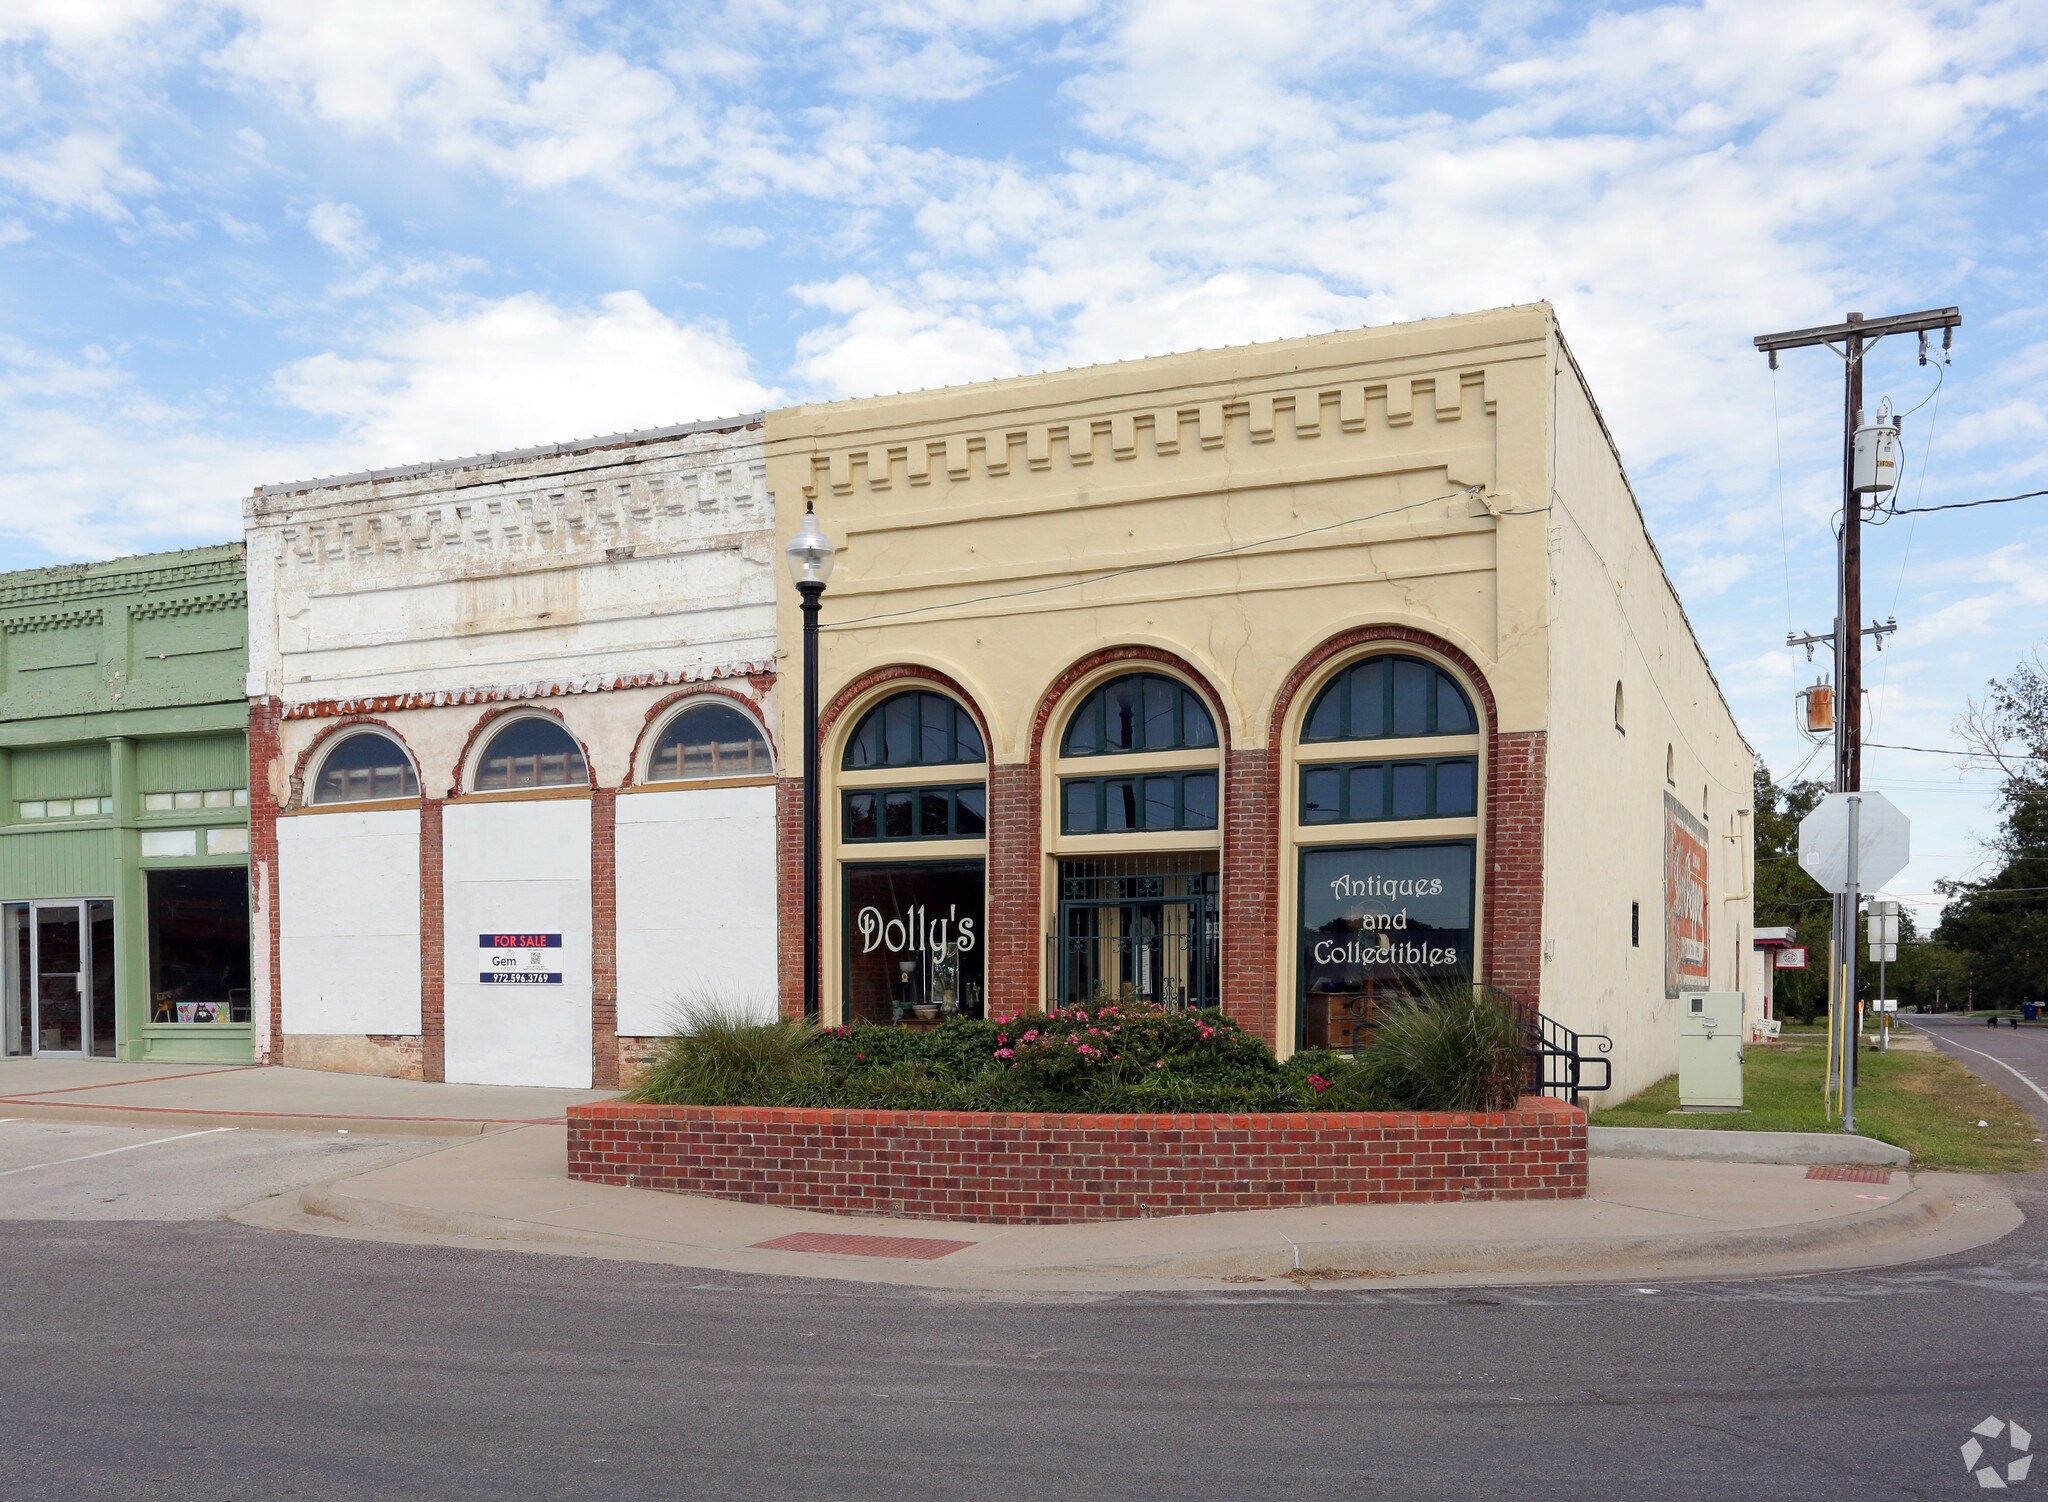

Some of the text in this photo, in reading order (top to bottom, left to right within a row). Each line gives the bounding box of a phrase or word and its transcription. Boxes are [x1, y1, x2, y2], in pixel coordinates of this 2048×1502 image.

[1330, 874, 1443, 901] Antiques
[1362, 907, 1407, 930] and
[494, 935, 547, 947] FOR SALE
[857, 904, 975, 964] Dolly's
[492, 956, 516, 966] Gem
[1314, 939, 1458, 967] Collectibles
[493, 973, 549, 983] 972.596.3769
